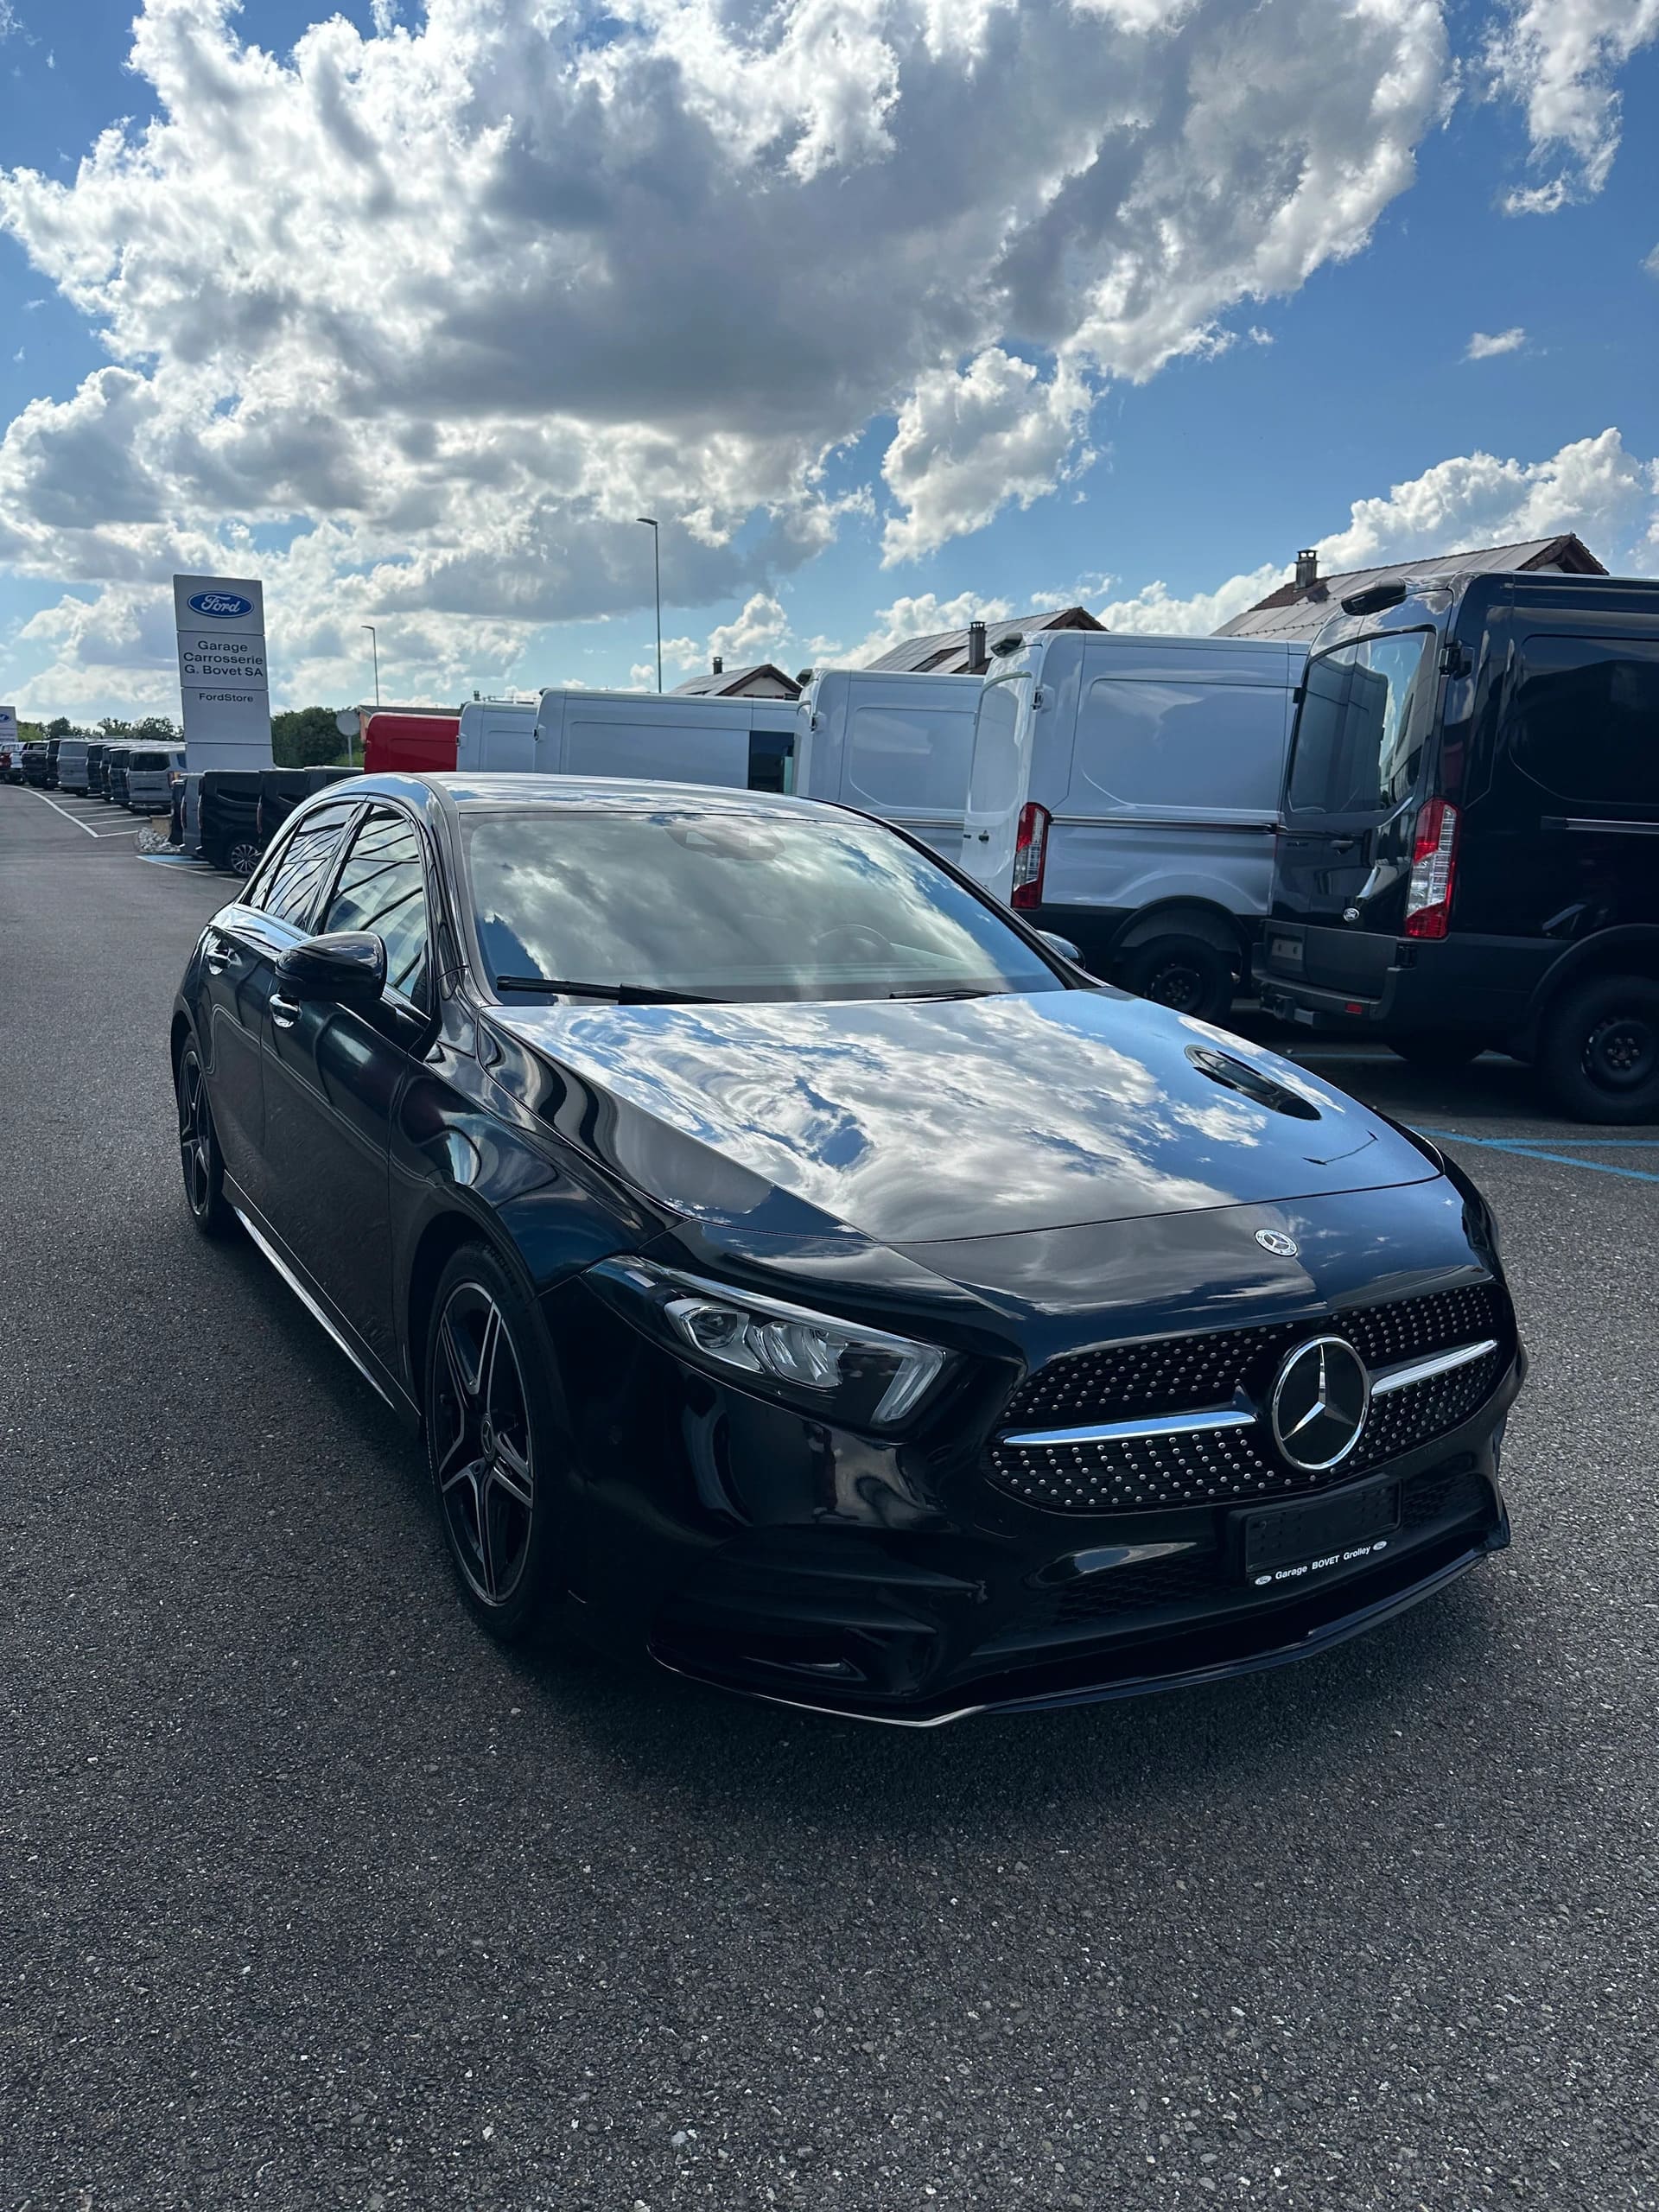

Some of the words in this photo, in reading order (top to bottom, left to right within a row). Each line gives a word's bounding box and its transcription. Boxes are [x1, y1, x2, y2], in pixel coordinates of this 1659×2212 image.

[200, 594, 241, 613] Ford
[198, 640, 248, 653] Garage
[183, 652, 263, 664] Carrosserie
[184, 664, 200, 674] G.
[203, 665, 242, 676] Bovet
[245, 666, 264, 677] SA
[199, 692, 254, 702] FordStore
[1274, 1565, 1307, 1580] Garage
[1312, 1554, 1340, 1570] BOVET
[1343, 1545, 1371, 1560] Grolley
